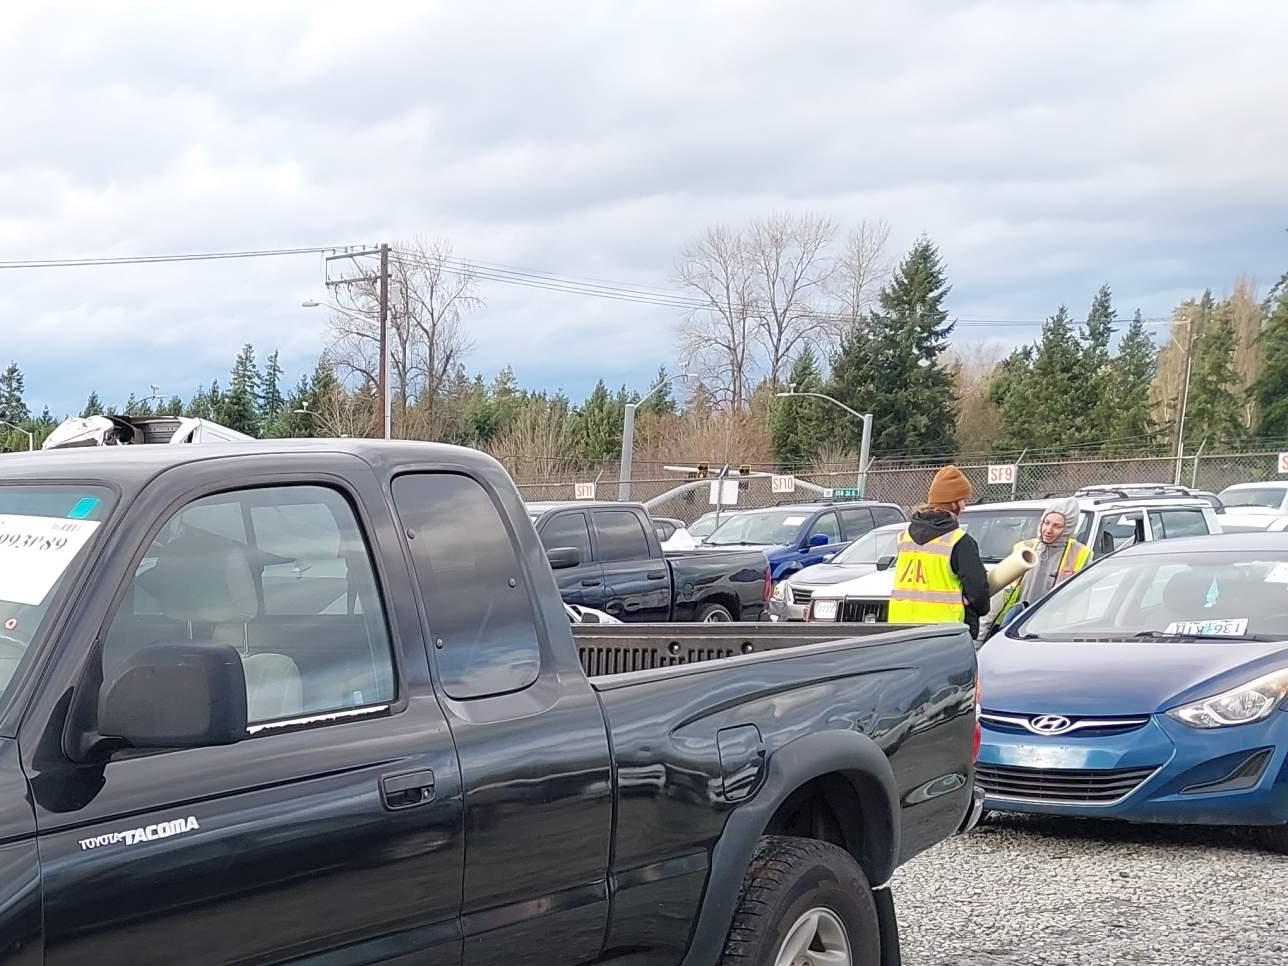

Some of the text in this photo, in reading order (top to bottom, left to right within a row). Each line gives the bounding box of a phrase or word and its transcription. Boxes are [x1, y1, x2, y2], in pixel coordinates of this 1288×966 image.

[990, 467, 1013, 481] SF9
[773, 477, 793, 490] SF10
[577, 485, 592, 497] SF11
[78, 816, 200, 850] TOYOTA TACOMA
